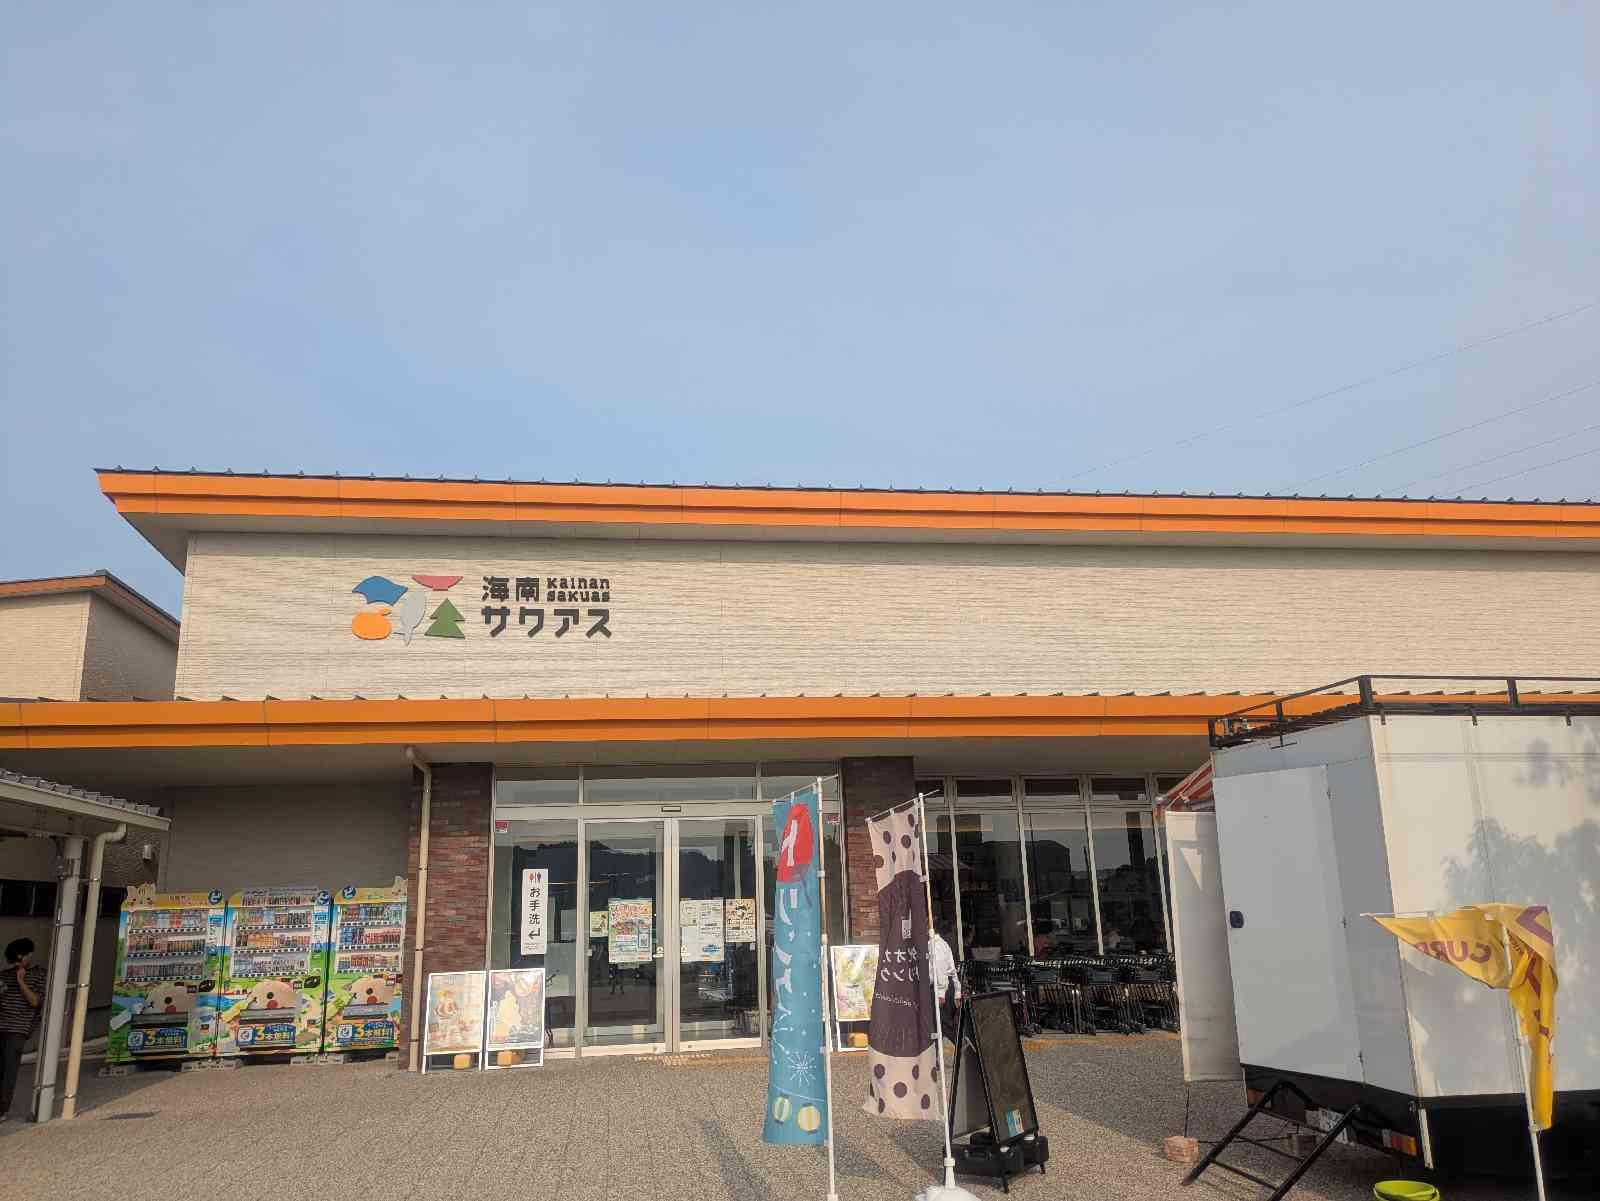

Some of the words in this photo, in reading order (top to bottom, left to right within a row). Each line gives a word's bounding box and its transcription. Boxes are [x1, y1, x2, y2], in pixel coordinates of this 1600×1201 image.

[482, 576, 540, 602] 海南
[481, 606, 612, 638] サクアス
[528, 887, 542, 925] お手洗
